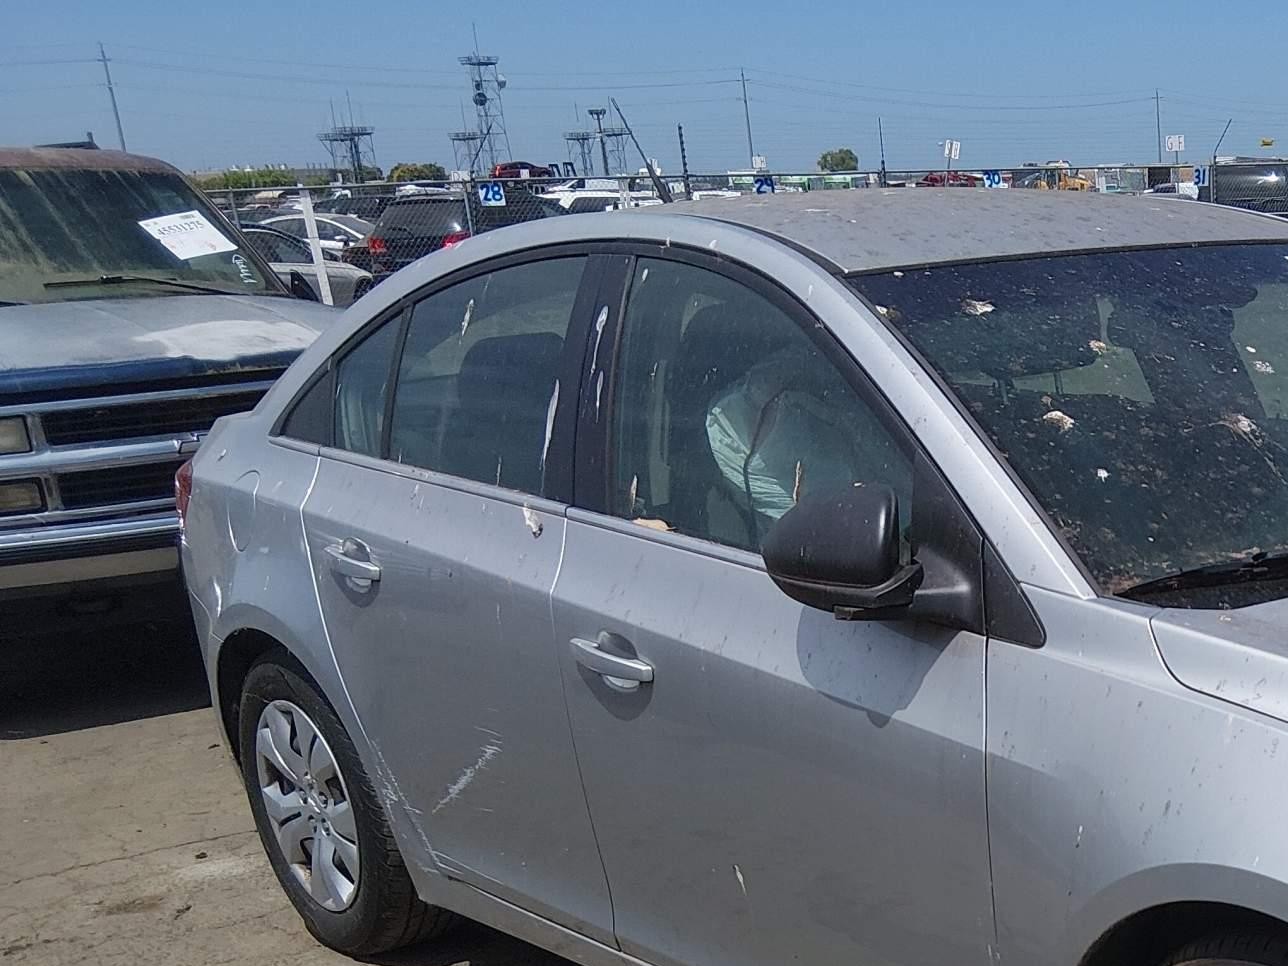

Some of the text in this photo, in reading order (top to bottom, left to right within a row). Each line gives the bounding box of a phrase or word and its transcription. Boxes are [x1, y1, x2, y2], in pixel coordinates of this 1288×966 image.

[983, 171, 1001, 188] 30
[1194, 168, 1206, 186] 31
[479, 182, 503, 202] 28
[157, 219, 205, 237] 45531275
